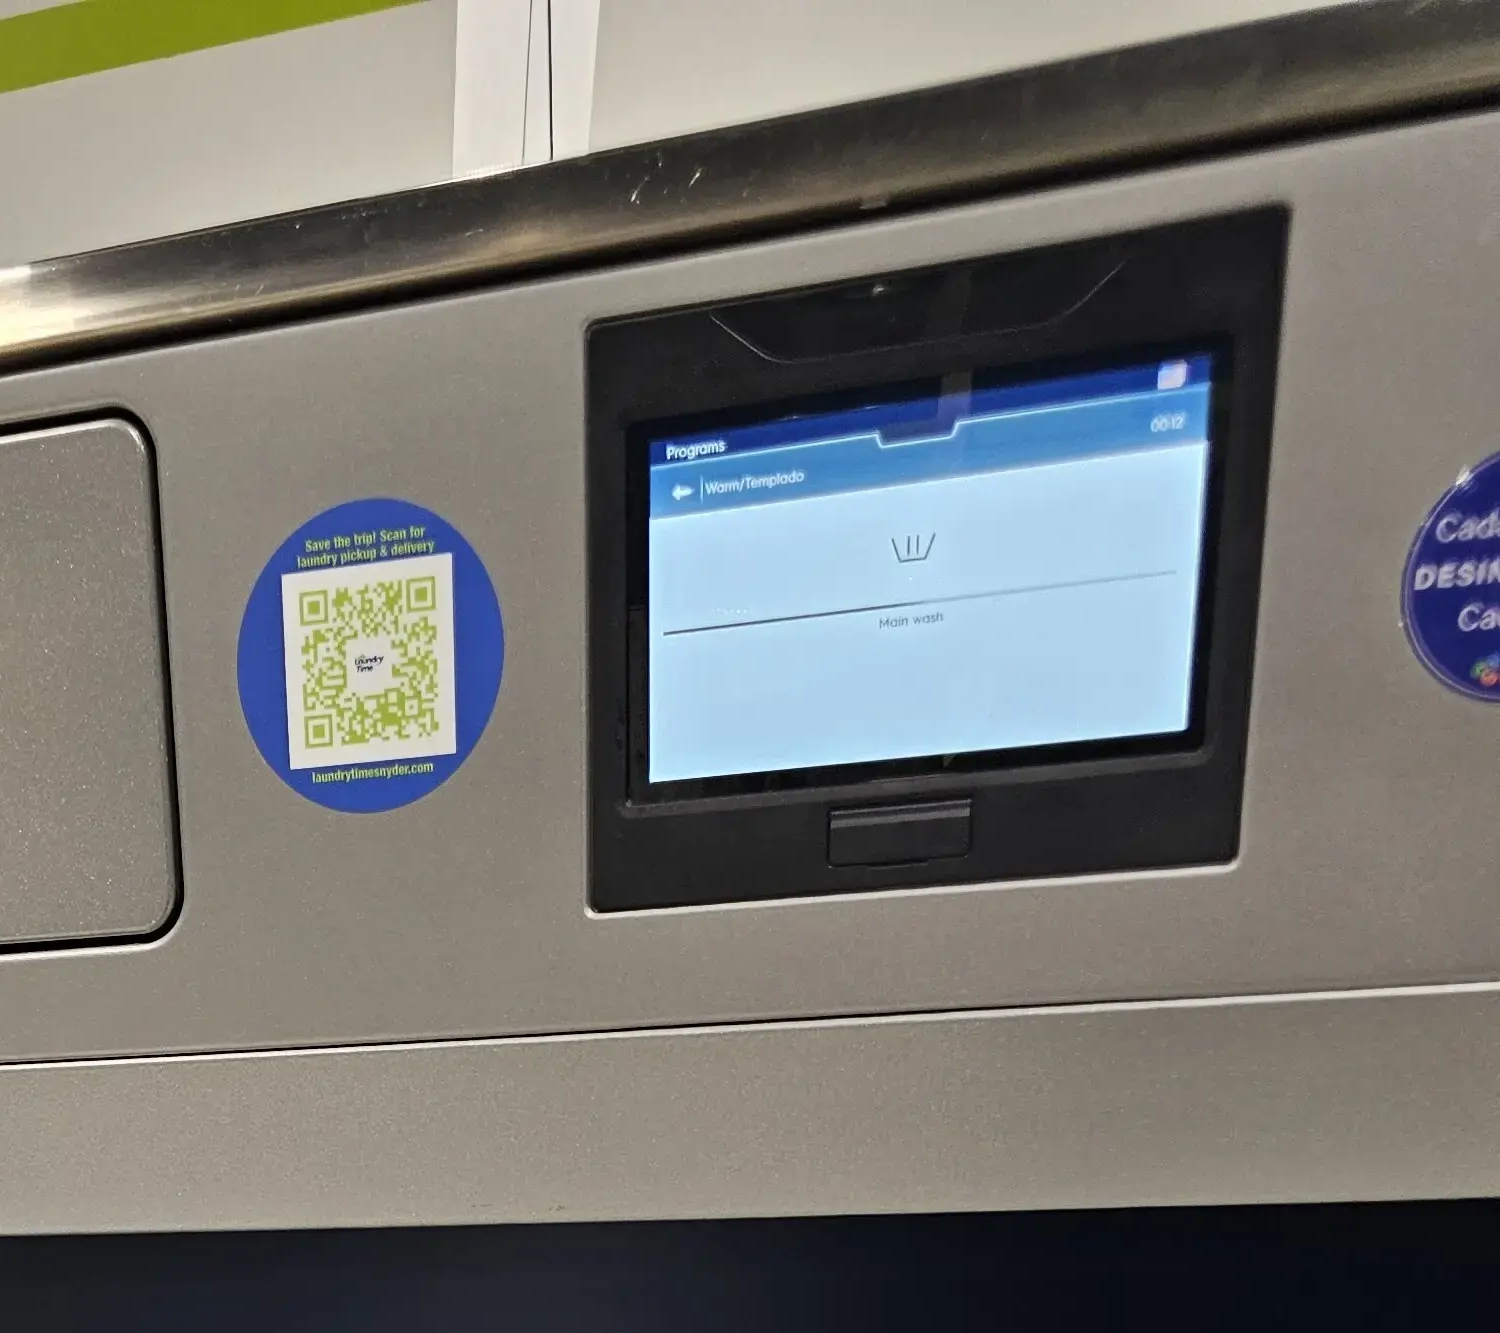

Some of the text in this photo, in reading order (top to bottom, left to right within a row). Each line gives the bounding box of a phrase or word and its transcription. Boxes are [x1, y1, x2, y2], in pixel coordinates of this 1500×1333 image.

[666, 439, 726, 460] Programs
[705, 470, 806, 495] Warm/Templado
[305, 525, 426, 553] Save the trip! Scan for
[297, 540, 435, 569] laundry pickup & delivery
[879, 611, 944, 629] Main wash
[357, 664, 374, 673] Time
[312, 762, 434, 783] laundrytimesnyder.com
